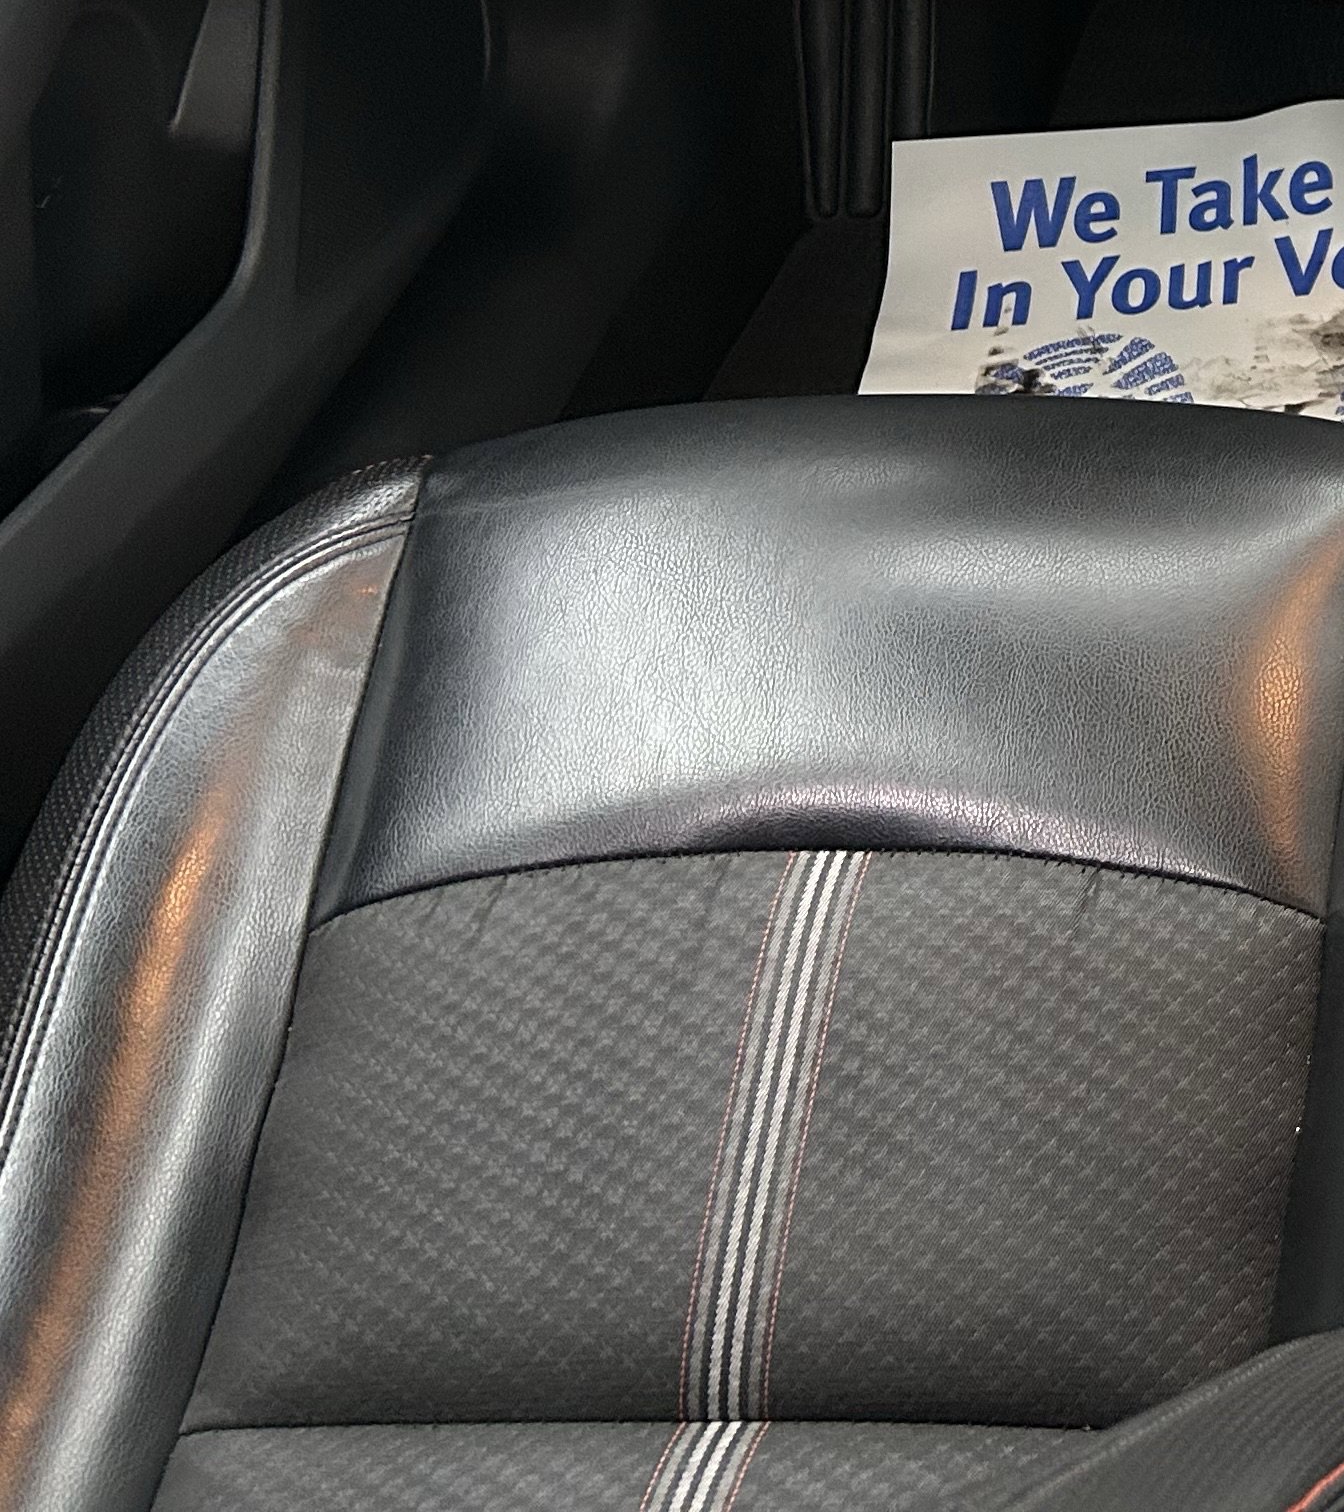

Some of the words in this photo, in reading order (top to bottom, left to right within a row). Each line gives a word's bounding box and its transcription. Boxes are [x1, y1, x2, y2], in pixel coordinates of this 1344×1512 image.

[990, 175, 1121, 253] We
[1145, 153, 1334, 235] Take
[950, 269, 1032, 332] In
[1061, 254, 1256, 320] Your
